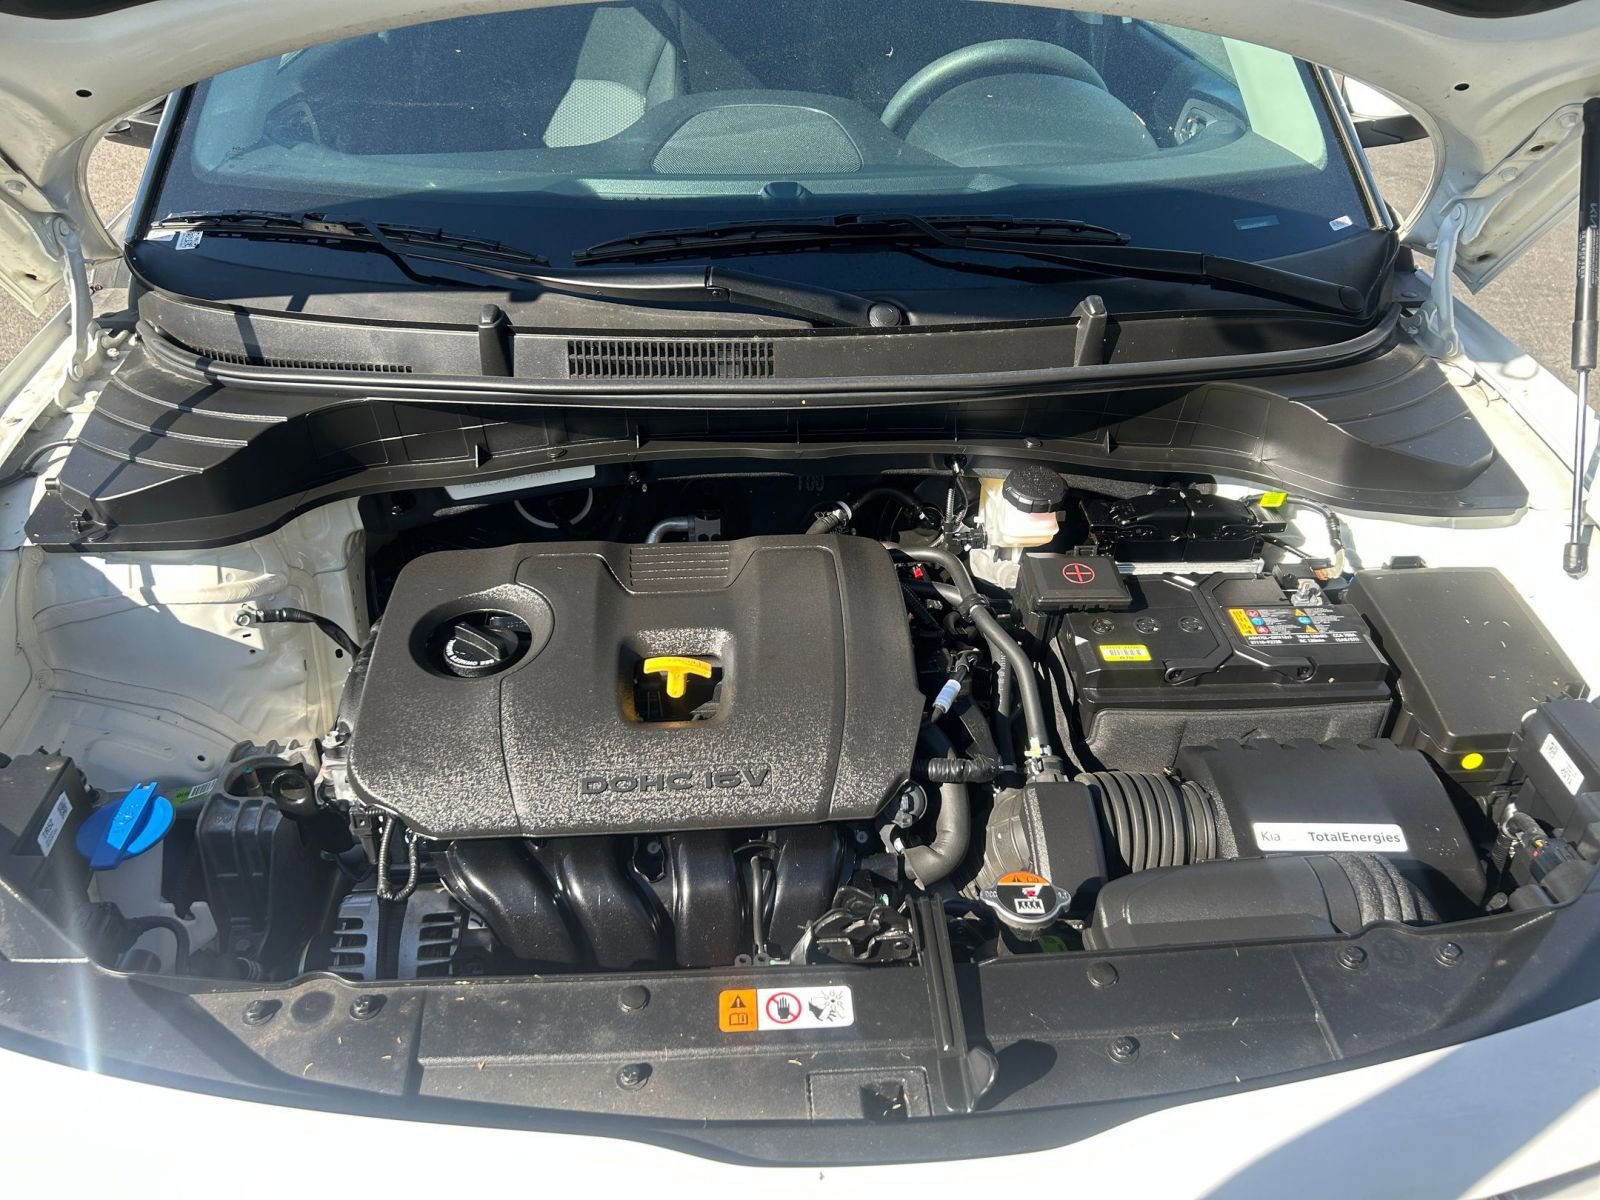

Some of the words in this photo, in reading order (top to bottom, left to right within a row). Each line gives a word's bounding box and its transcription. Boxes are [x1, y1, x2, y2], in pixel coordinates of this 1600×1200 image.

[581, 772, 693, 795] DOHC
[704, 767, 770, 790] 16V
[1260, 831, 1281, 842] Kia
[1308, 831, 1401, 845] TotalEnergies
